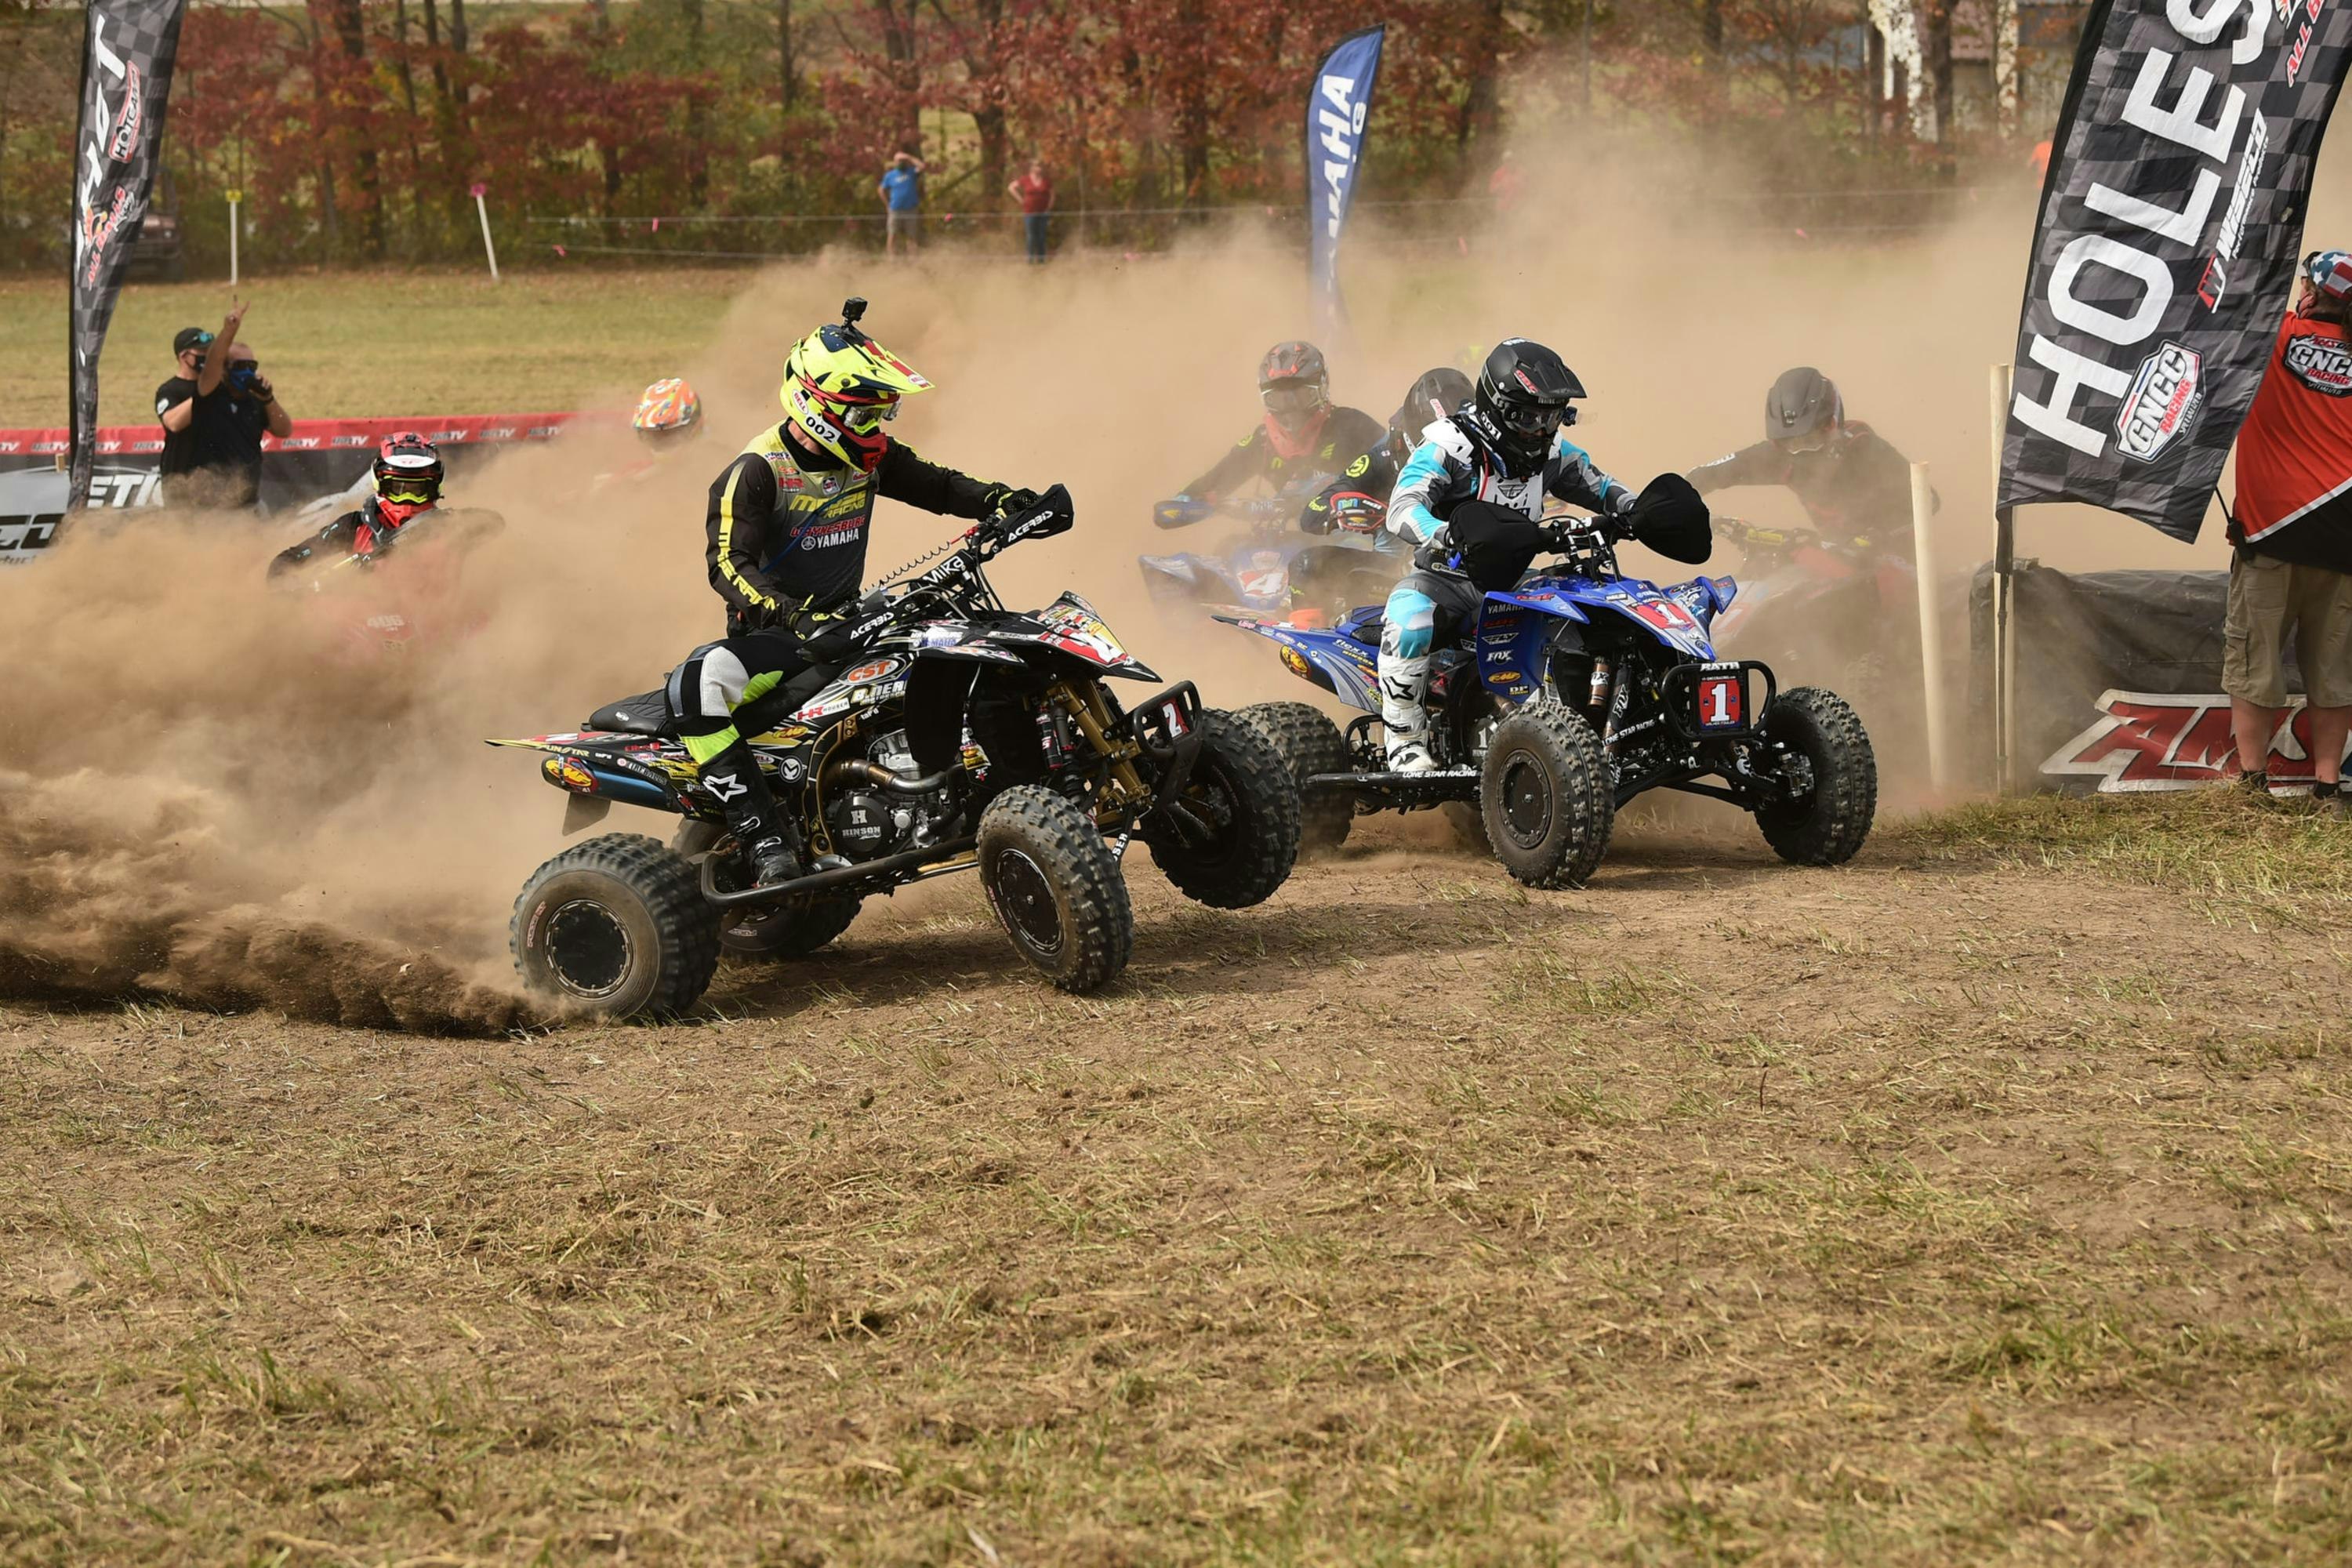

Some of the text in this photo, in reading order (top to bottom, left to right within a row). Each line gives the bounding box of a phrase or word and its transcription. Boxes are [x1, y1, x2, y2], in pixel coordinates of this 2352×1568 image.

[2290, 345, 2352, 378] GNC
[793, 391, 807, 412] BELL
[2127, 349, 2187, 454] GNCC
[2159, 377, 2193, 437] RACING
[804, 416, 836, 443] 002
[817, 528, 859, 549] YAMAHA
[1008, 510, 1054, 543] ACERBIS
[850, 612, 895, 640] ACERBIS
[848, 661, 891, 683] CST
[1711, 683, 1730, 722] 1
[1163, 702, 1183, 739] 2
[851, 809, 868, 825] H
[842, 826, 881, 837] HINSON
